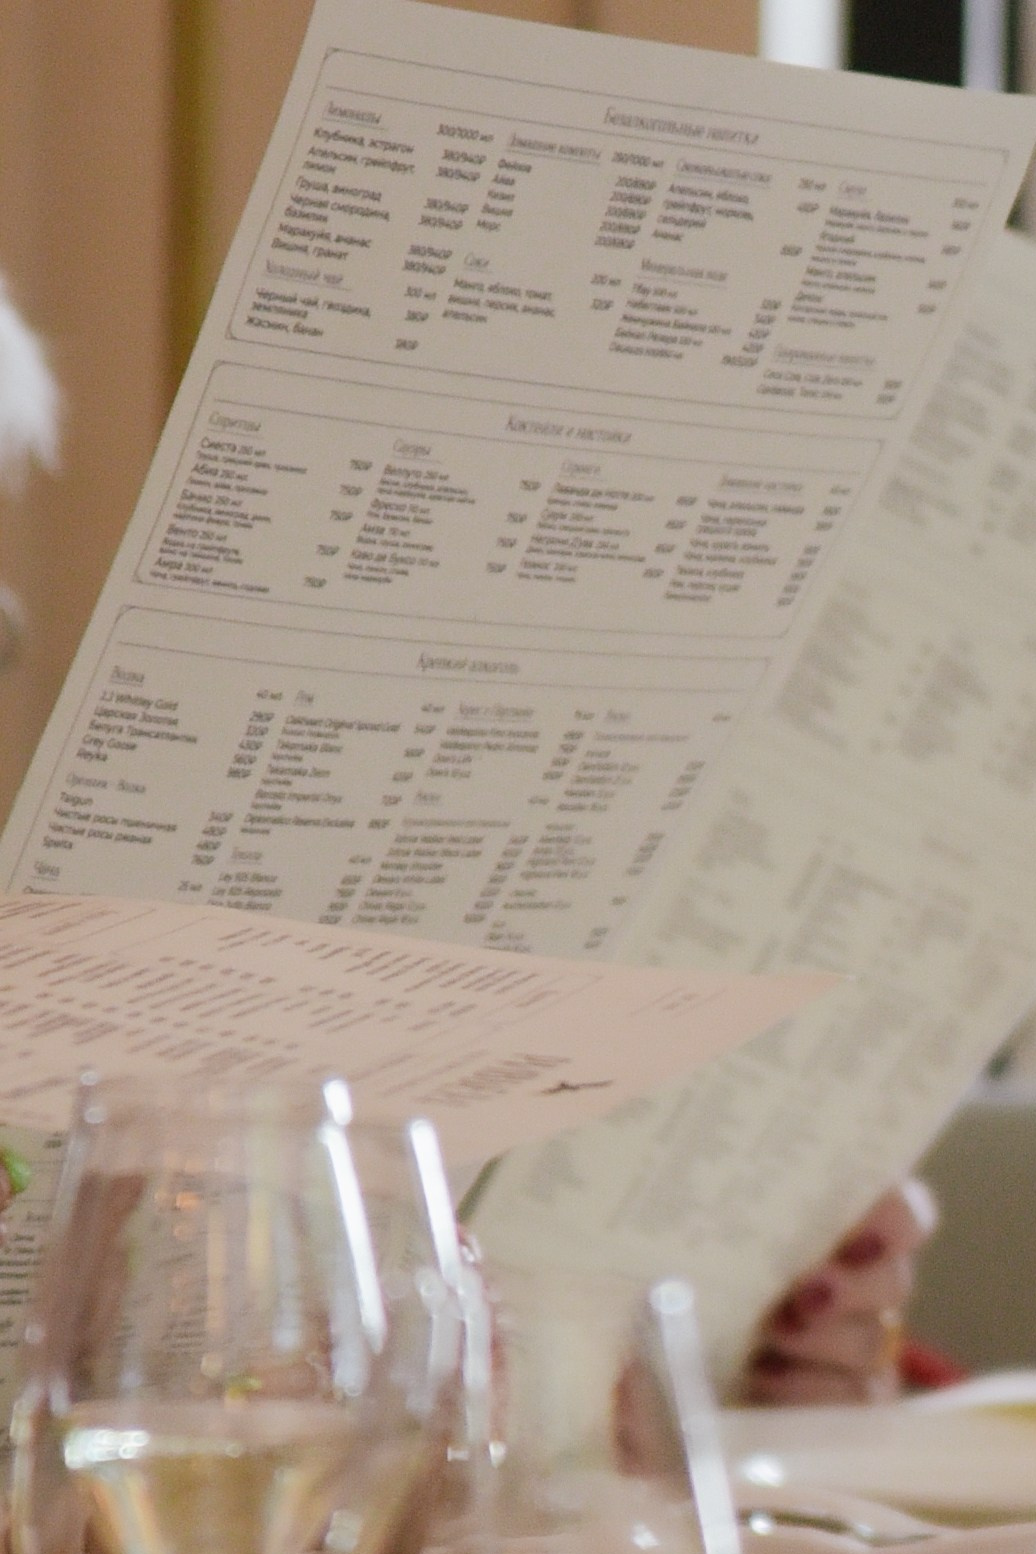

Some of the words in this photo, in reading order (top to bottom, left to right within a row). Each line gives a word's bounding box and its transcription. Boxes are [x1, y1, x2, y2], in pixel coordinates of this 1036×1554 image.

[603, 106, 705, 137] Безалкогольные
[706, 128, 759, 145] напитки
[313, 127, 365, 146] Клубника,
[368, 139, 414, 153] эстрагон
[307, 146, 358, 163] Апельсин,
[295, 175, 331, 192] Груша,
